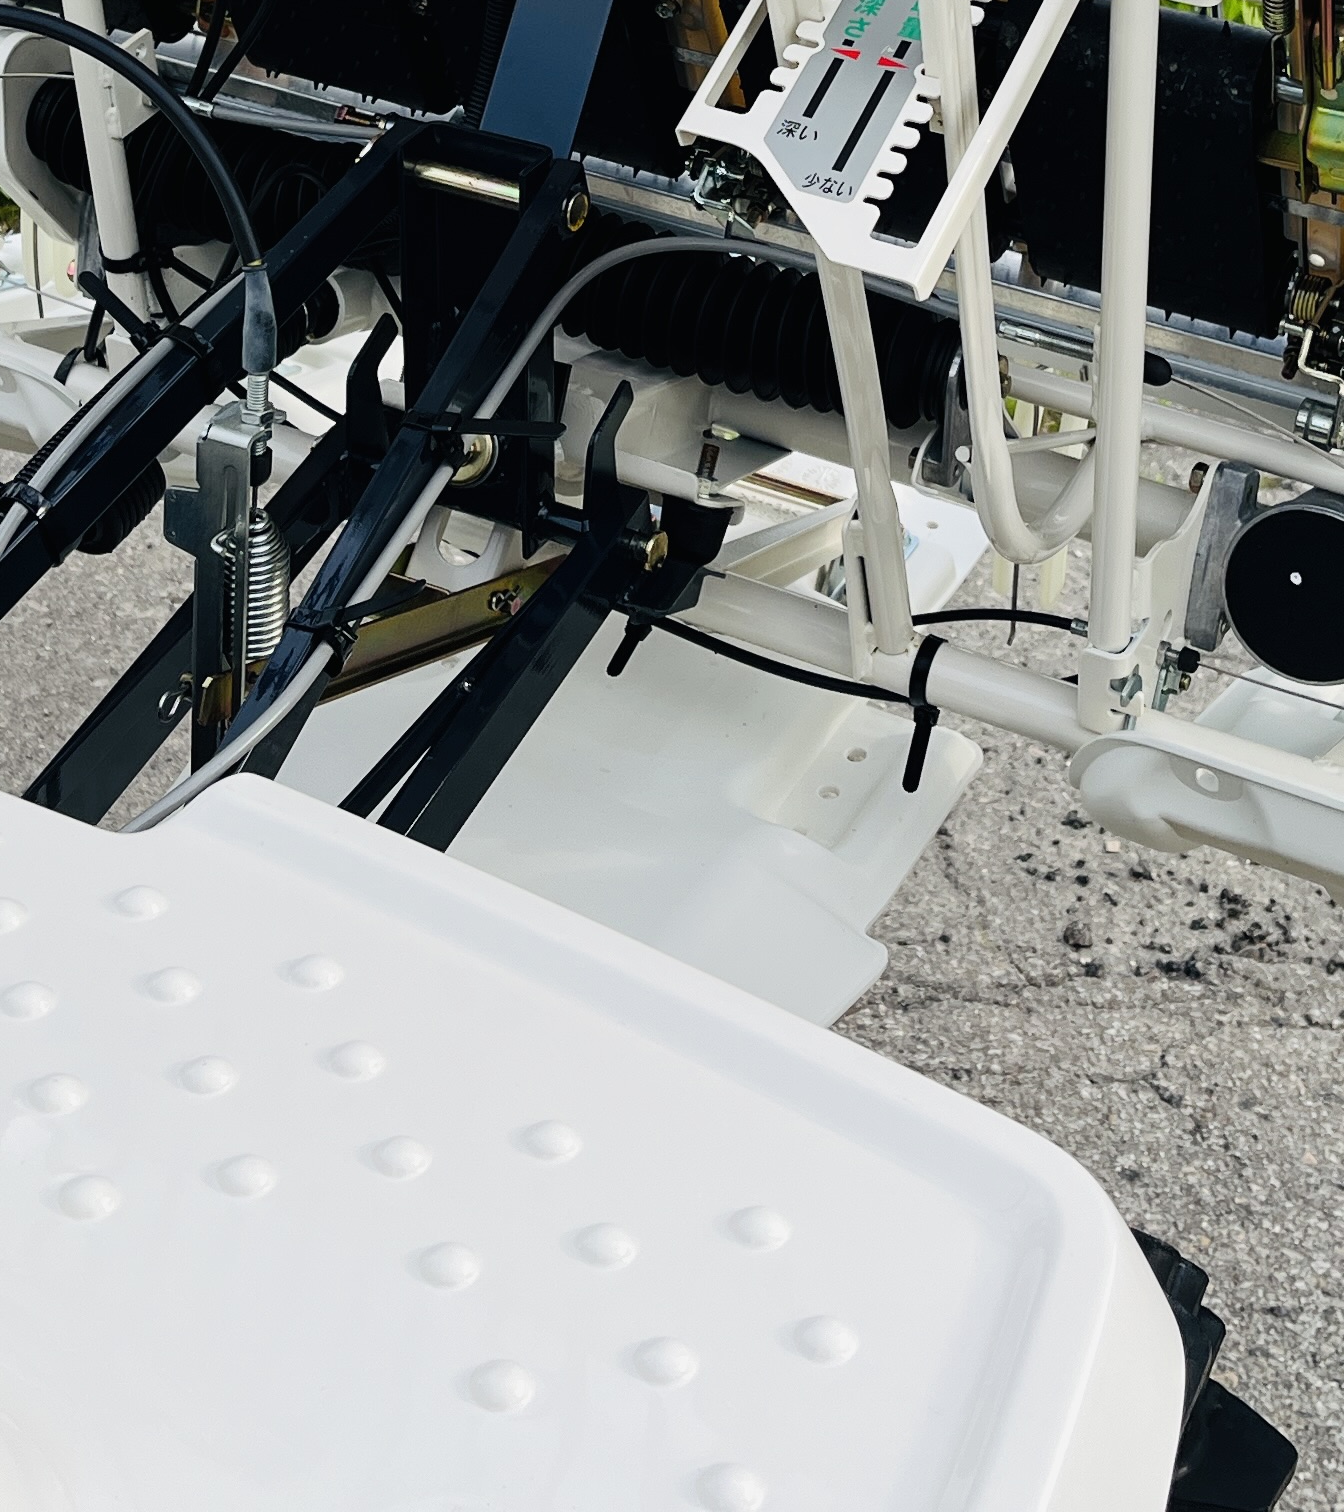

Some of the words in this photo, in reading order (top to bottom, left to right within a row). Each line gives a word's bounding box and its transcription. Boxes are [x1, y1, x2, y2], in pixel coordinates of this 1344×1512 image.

[776, 119, 818, 141] 深い
[801, 172, 853, 197] 少ない
